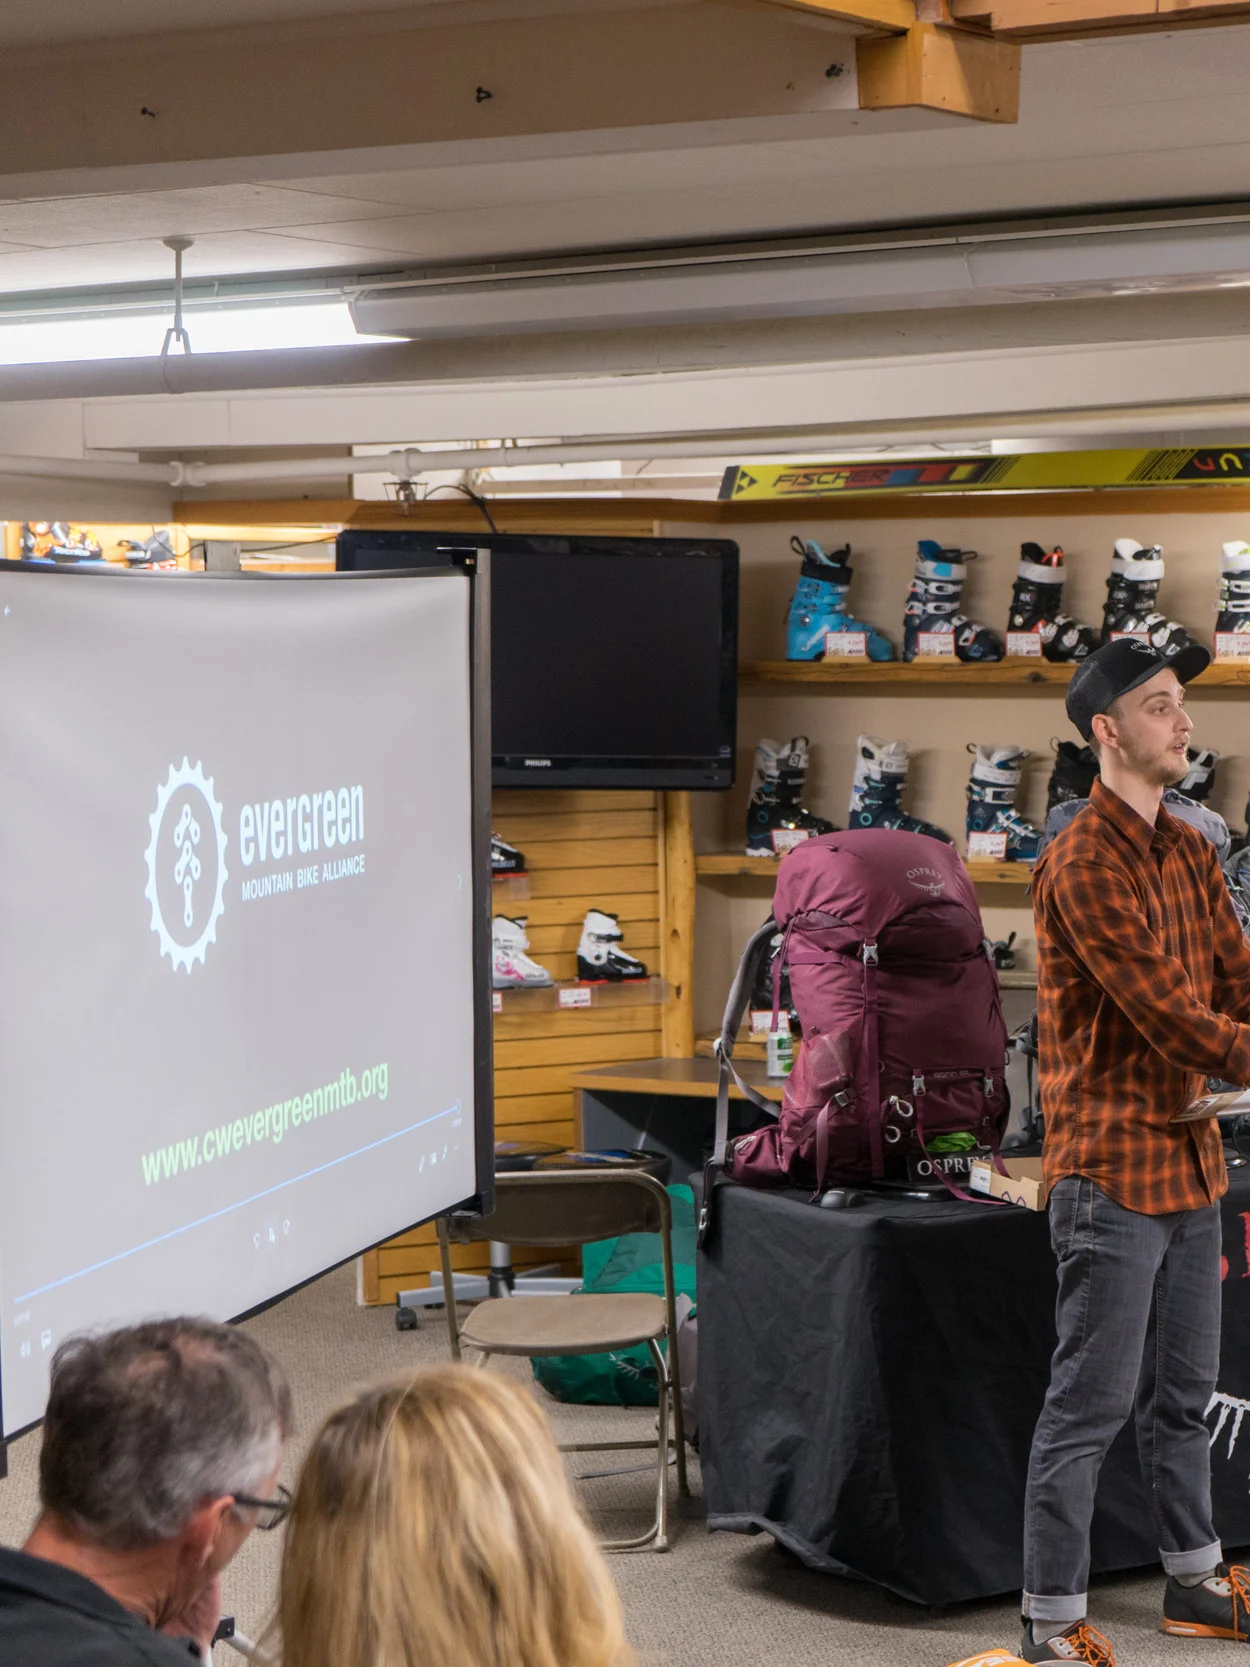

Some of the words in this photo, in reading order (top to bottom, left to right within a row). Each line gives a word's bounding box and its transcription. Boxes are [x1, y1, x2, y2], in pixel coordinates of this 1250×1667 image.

[771, 468, 894, 489] FISCHER
[525, 759, 552, 767] PHILIPS
[242, 871, 293, 901] MOUNTAIN
[297, 864, 319, 889] BIKE
[322, 854, 366, 882] ALLIANCE
[141, 1062, 388, 1187] www.cwevergreenmtb.org
